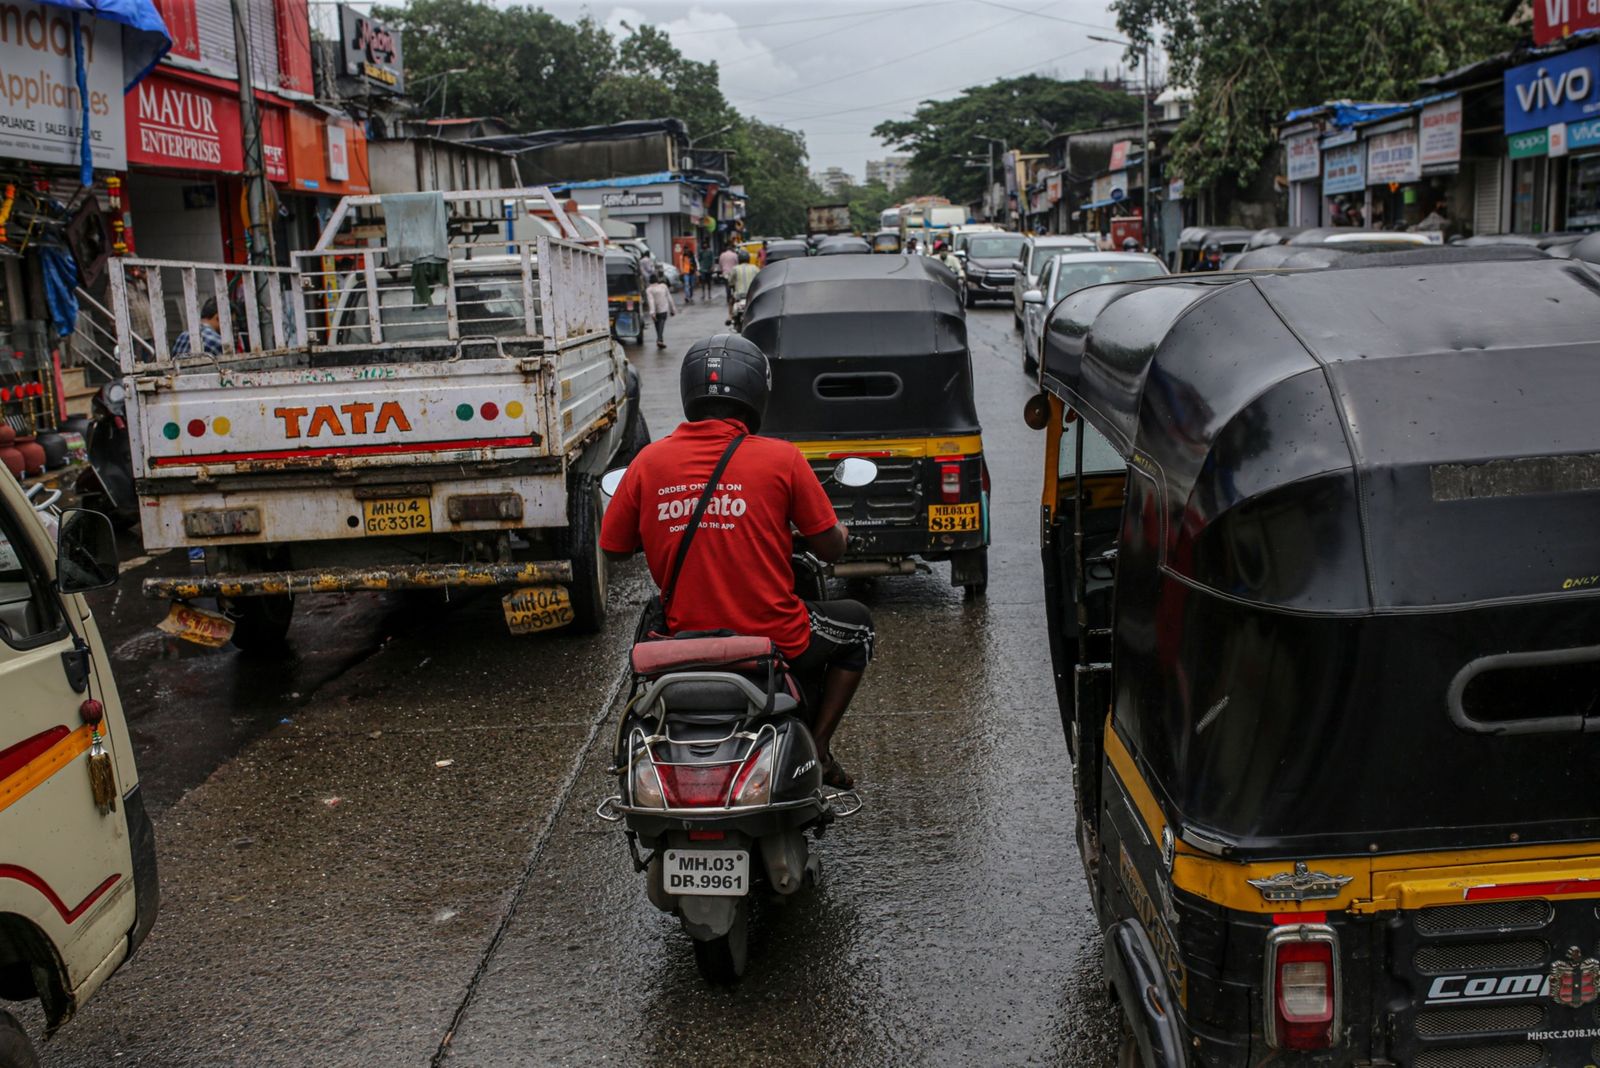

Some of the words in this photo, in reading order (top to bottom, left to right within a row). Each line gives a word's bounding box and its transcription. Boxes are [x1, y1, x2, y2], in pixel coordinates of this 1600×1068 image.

[139, 82, 218, 133] MAYUR
[1516, 67, 1590, 112] vivo
[141, 128, 221, 164] ENTERPRISES
[274, 401, 412, 439] TATA
[658, 484, 688, 496] ORDER
[930, 516, 977, 531] 8341
[678, 857, 735, 872] MH.03
